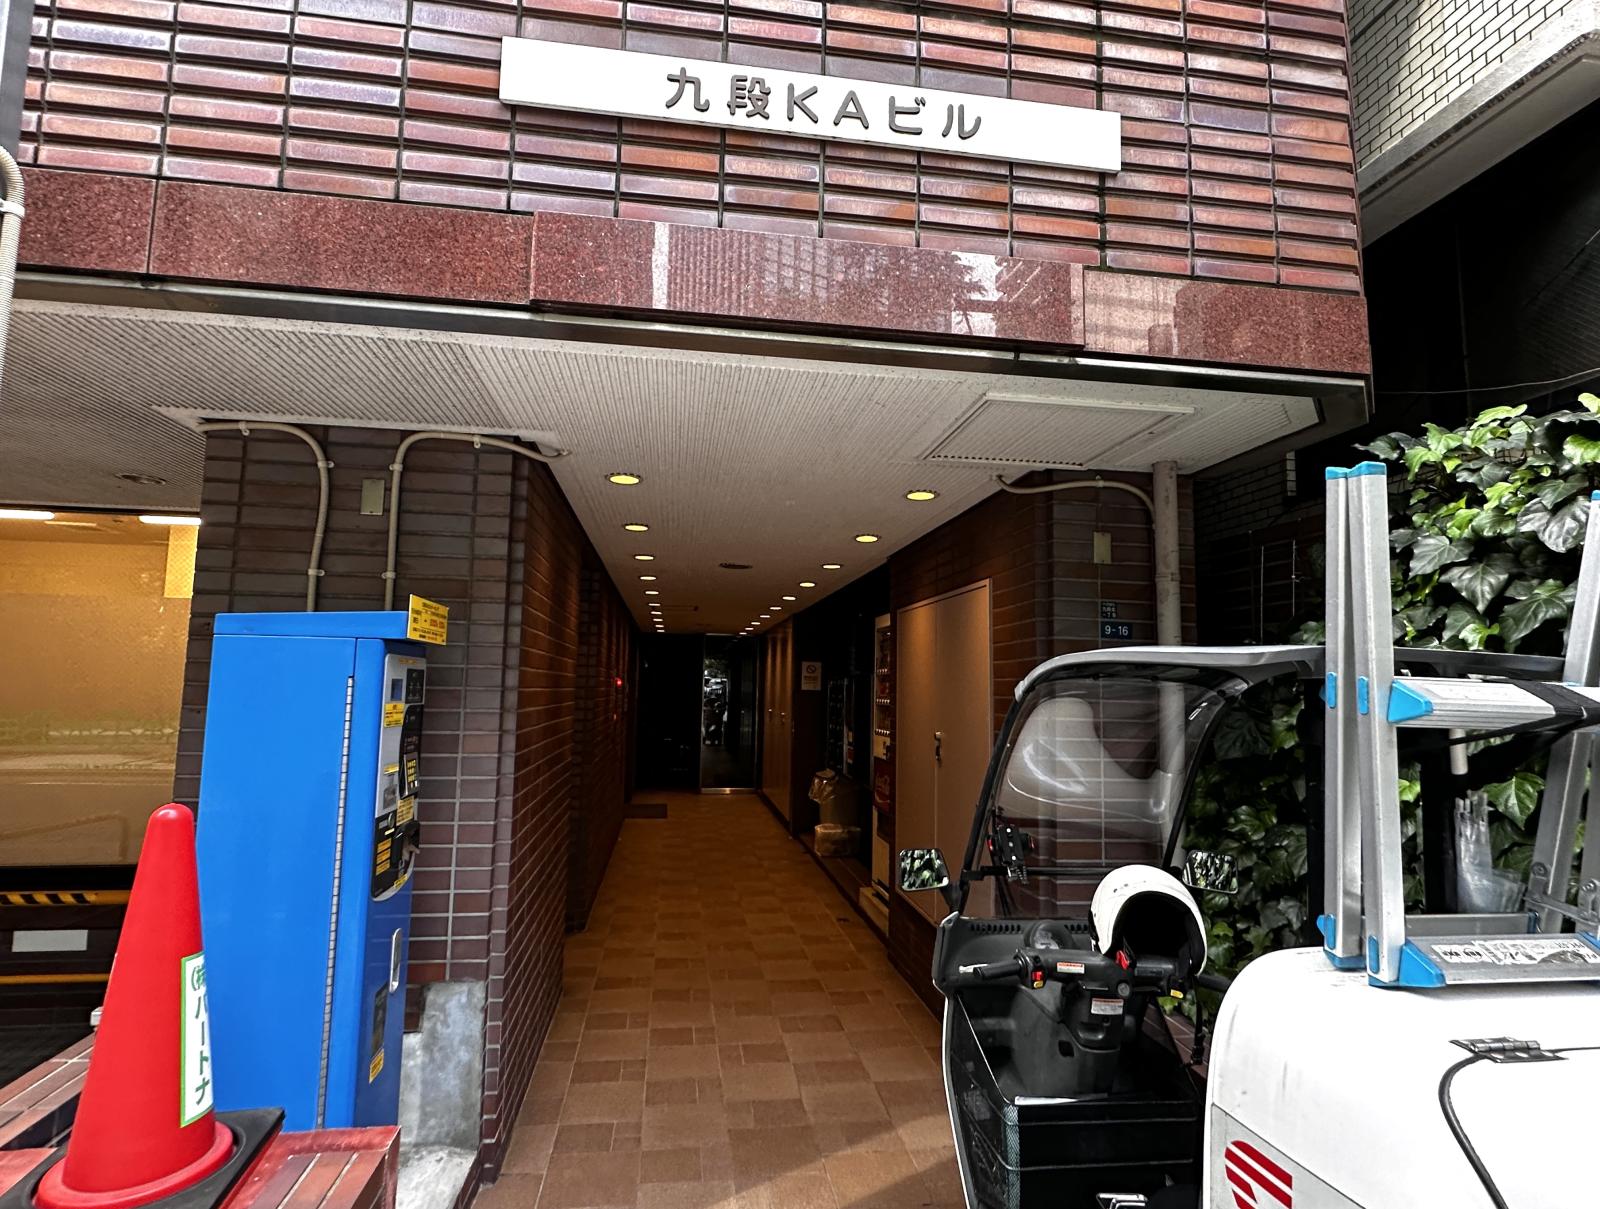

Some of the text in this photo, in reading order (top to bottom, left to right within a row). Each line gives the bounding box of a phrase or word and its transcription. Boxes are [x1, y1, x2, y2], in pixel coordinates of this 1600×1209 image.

[665, 66, 982, 140] 九段KAビル
[1104, 624, 1129, 636] 9-16
